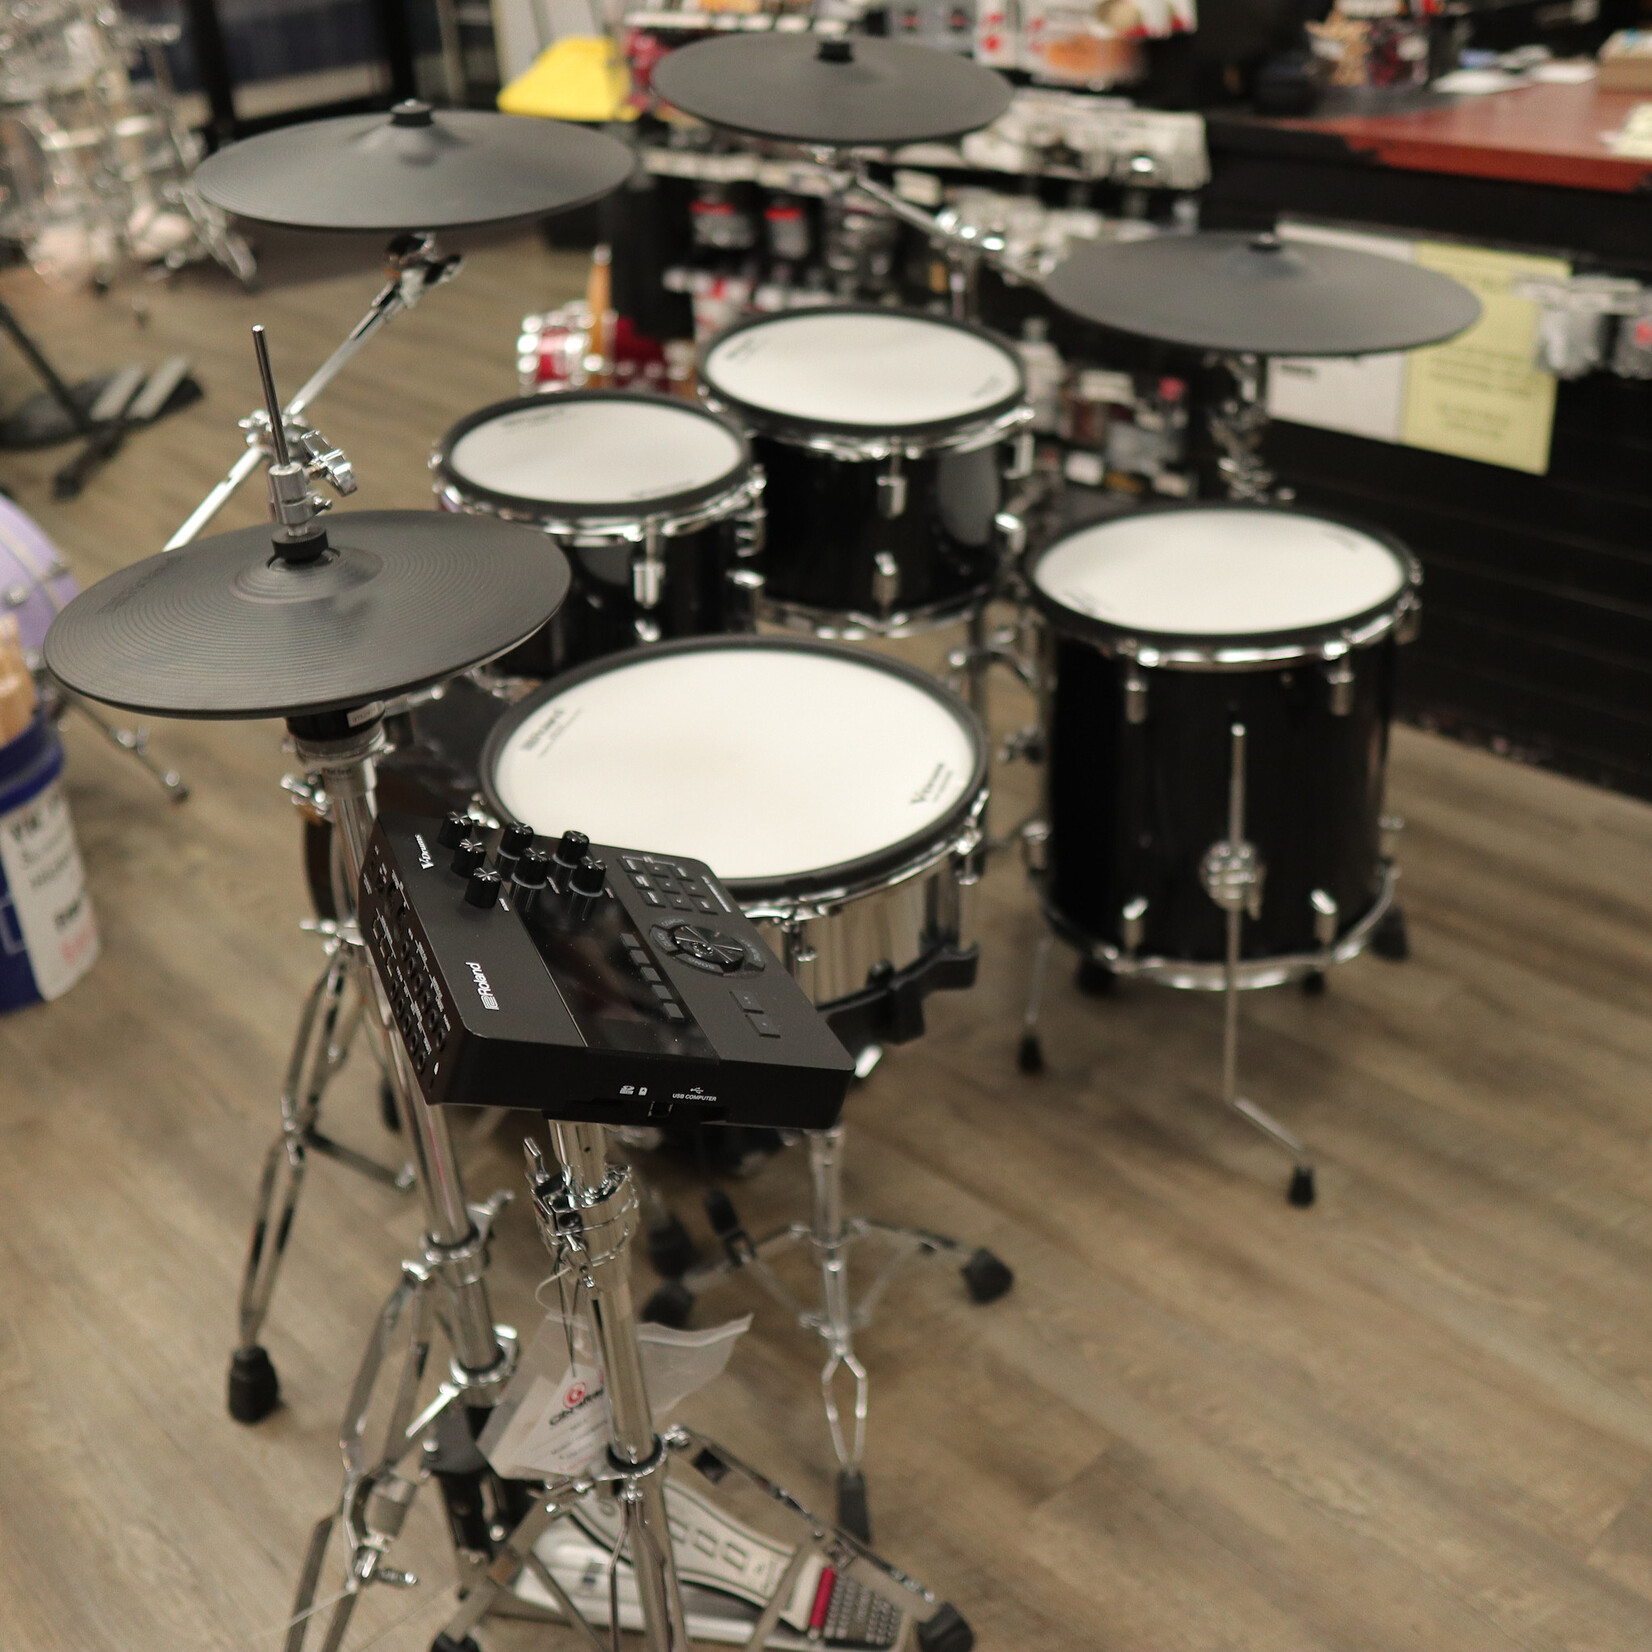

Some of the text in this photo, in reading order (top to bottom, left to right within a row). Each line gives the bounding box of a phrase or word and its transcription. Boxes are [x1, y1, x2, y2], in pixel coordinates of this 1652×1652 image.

[415, 834, 434, 869] V-Drums
[466, 961, 493, 997] Roland
[685, 1094, 717, 1102] COMPUTER
